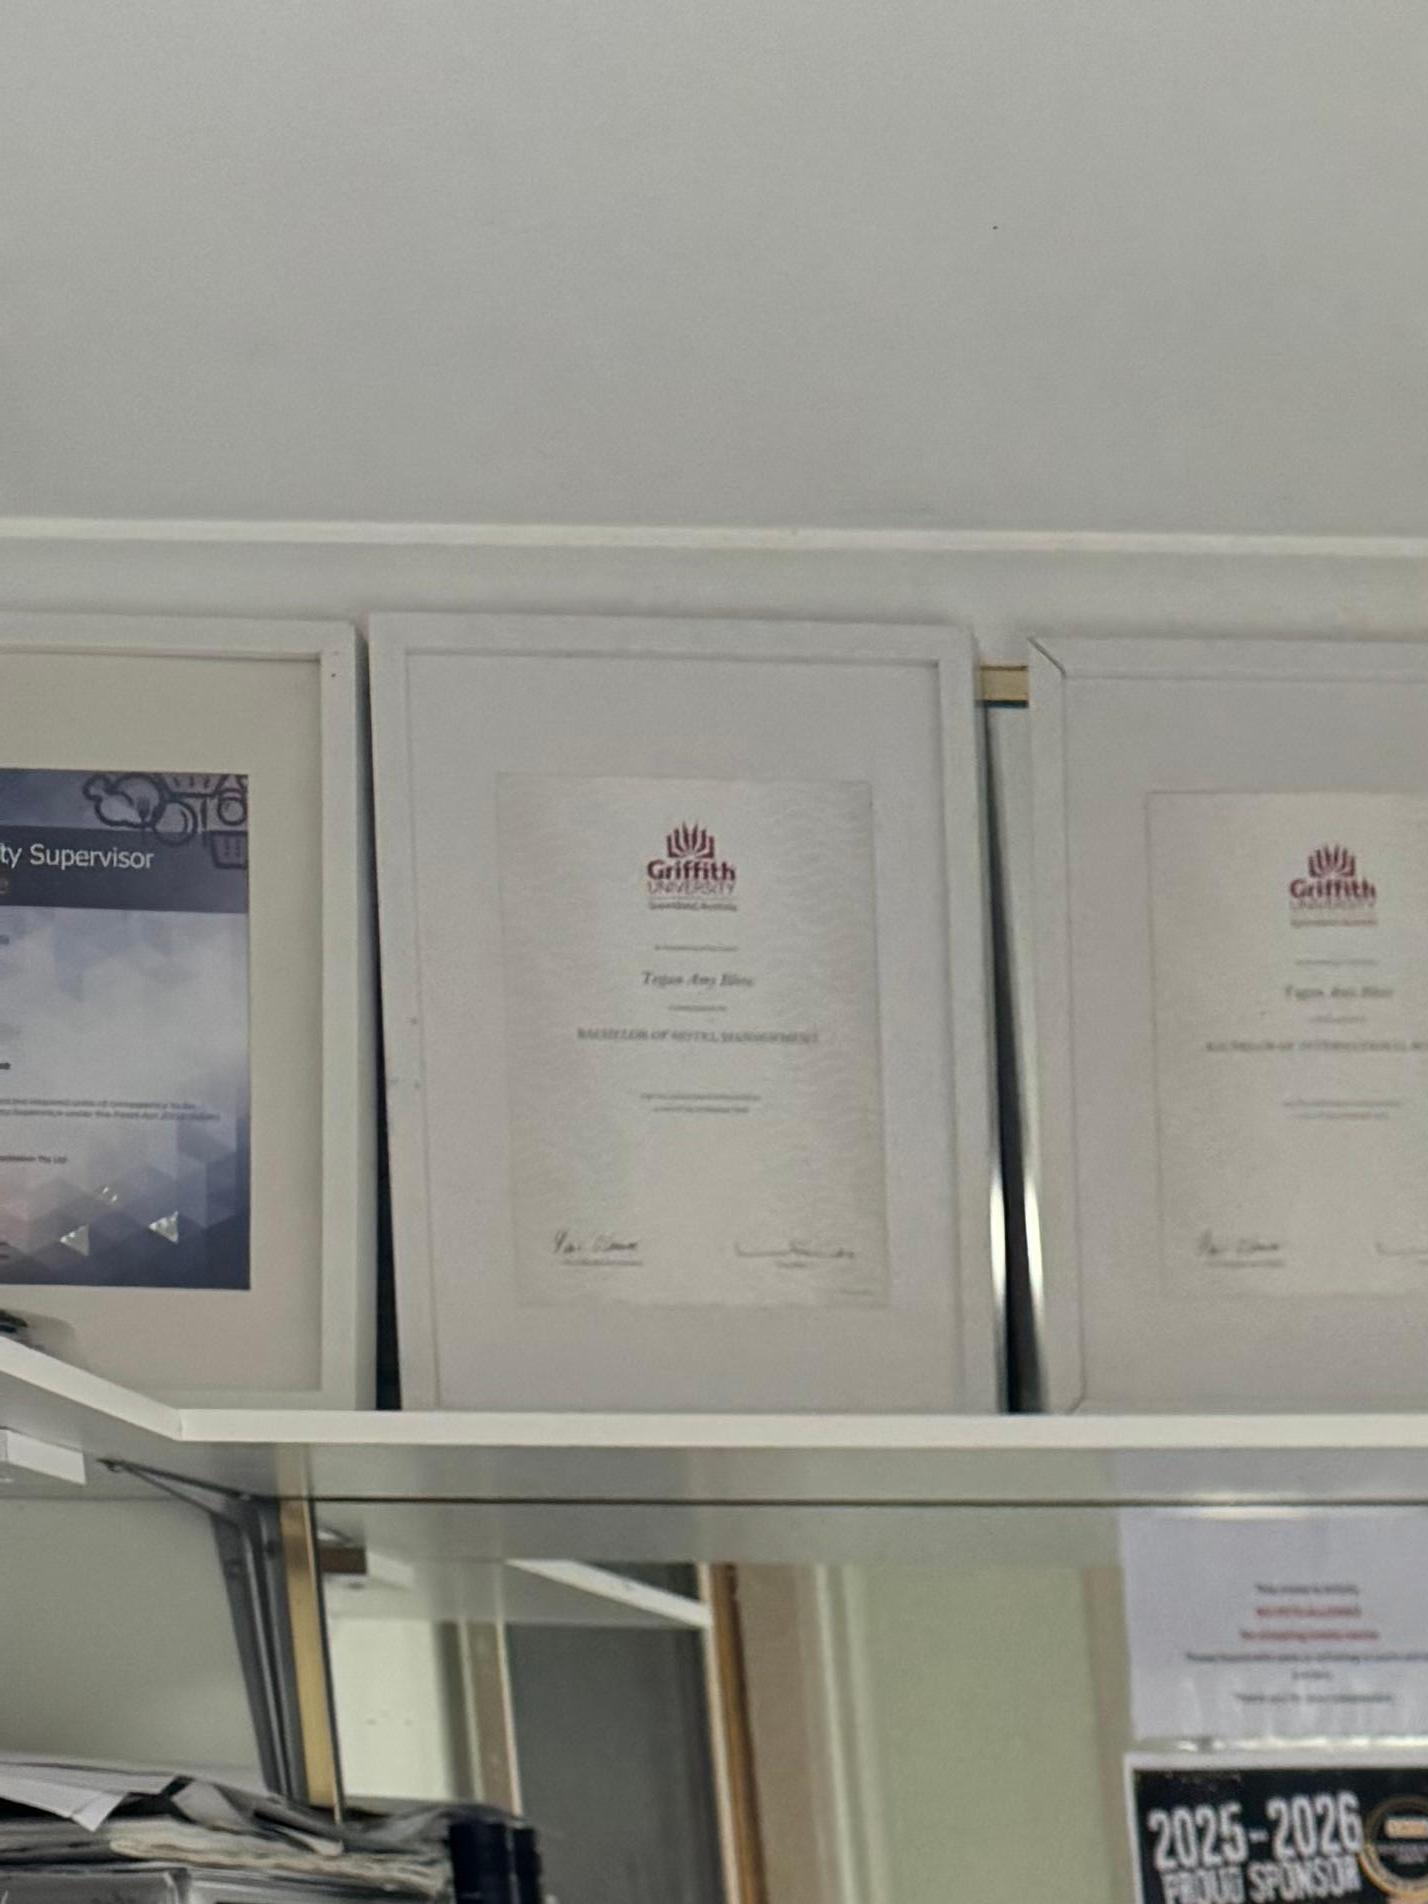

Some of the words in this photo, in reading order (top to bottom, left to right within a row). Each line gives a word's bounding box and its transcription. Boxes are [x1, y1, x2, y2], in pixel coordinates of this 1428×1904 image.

[30, 843, 154, 870] Supervisor
[647, 859, 737, 881] Griffith
[1289, 878, 1377, 900] Griffith
[1249, 1856, 1363, 1904] SPONSOR
